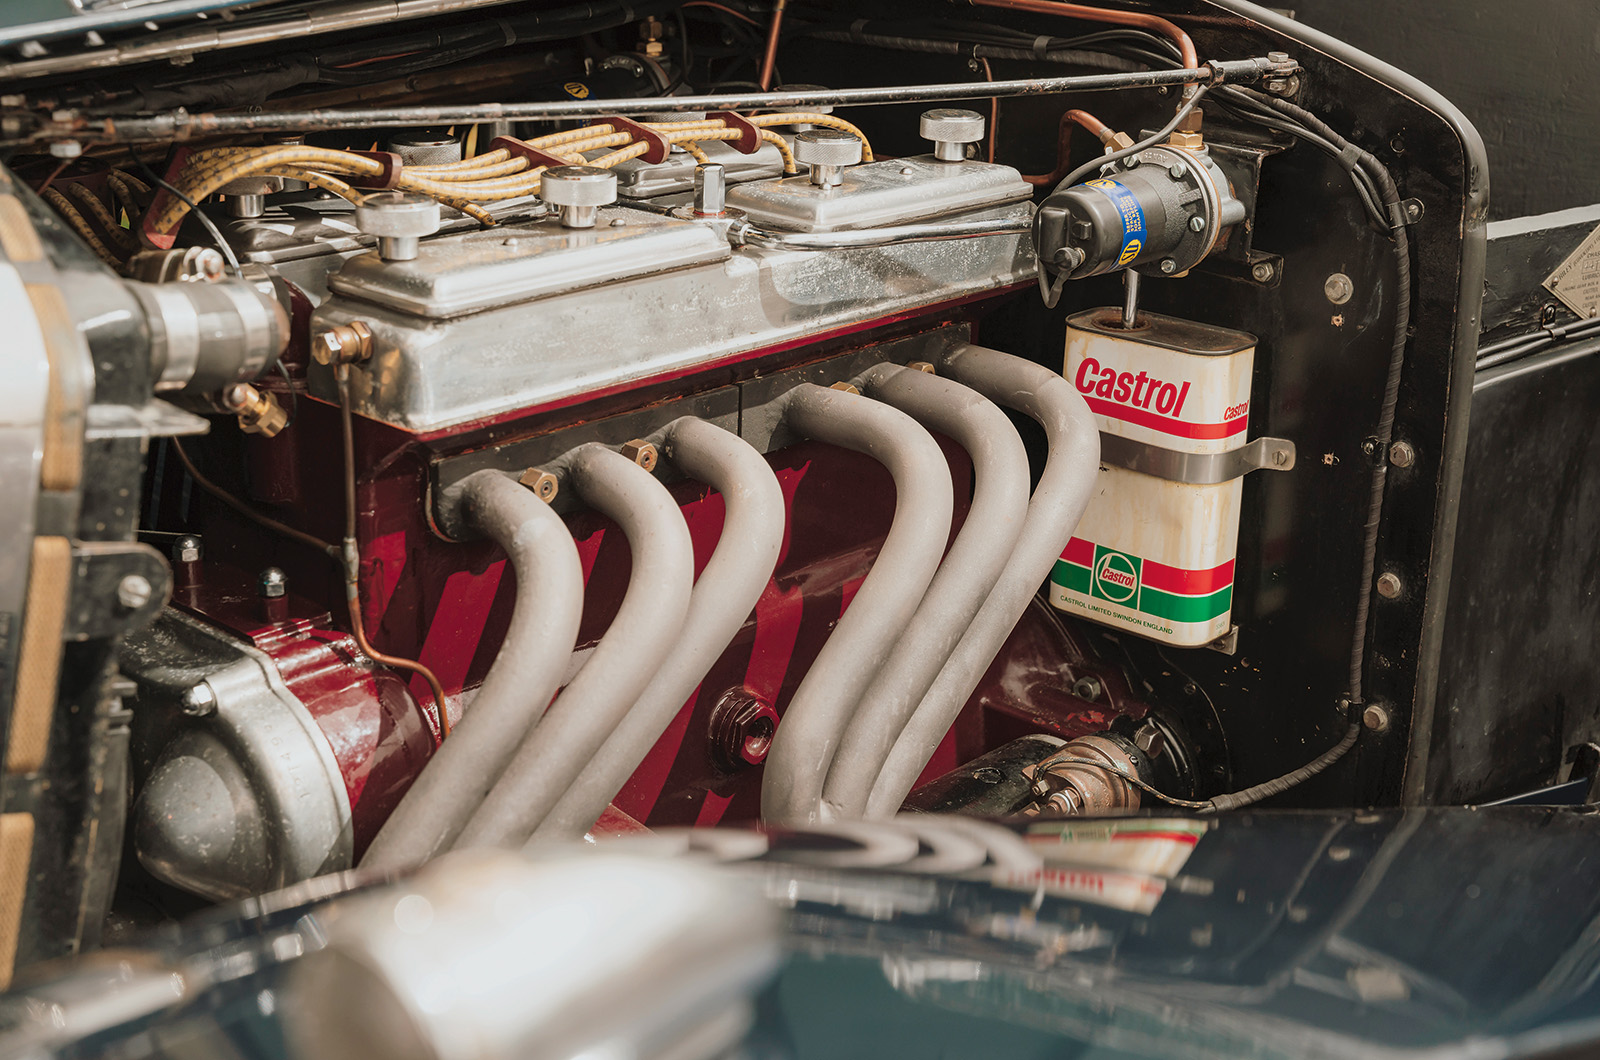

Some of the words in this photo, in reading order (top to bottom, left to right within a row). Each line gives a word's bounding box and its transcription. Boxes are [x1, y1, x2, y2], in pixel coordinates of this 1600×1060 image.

[1075, 357, 1191, 418] Castrol
[1224, 400, 1249, 421] Castrol
[1102, 568, 1135, 587] Castrol
[1060, 595, 1086, 608] CASTROL
[1087, 604, 1112, 616] LIMITED
[1112, 612, 1142, 625] SWINDON
[1142, 621, 1173, 635] ENGLAND
